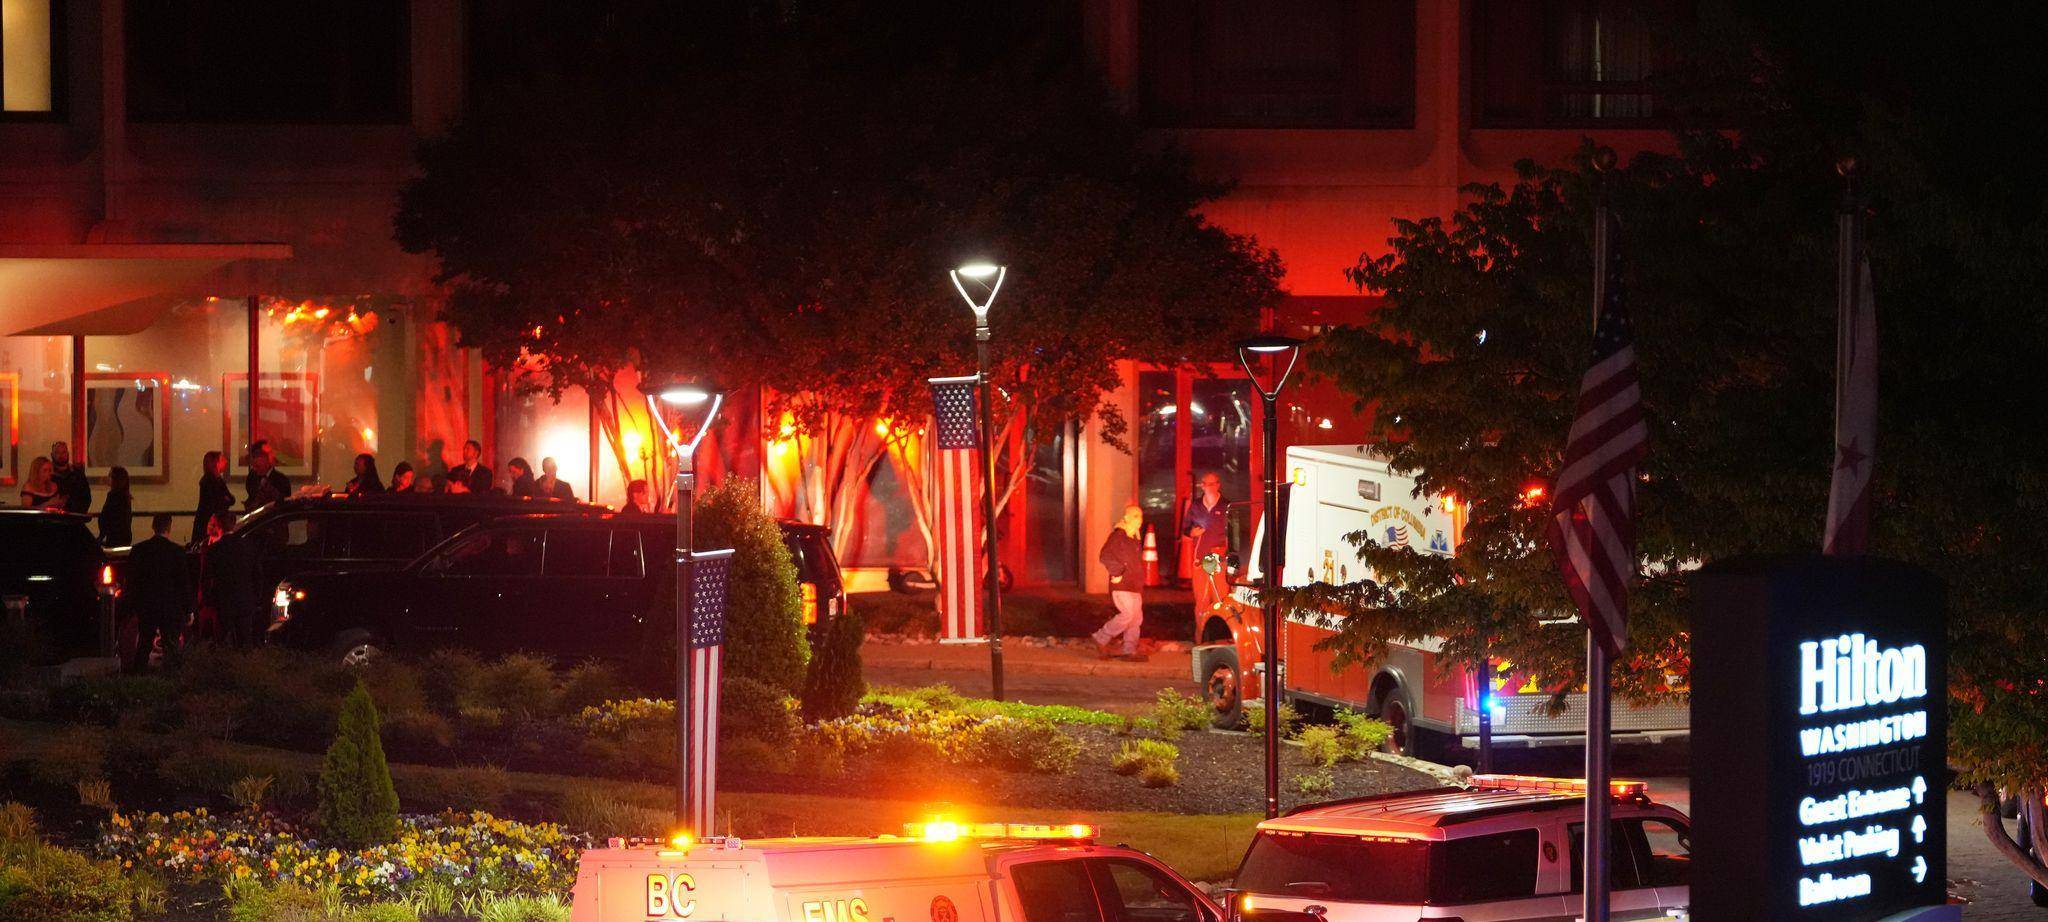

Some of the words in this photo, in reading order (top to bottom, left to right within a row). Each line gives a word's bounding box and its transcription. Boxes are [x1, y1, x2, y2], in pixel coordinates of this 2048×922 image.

[1800, 633, 1927, 715] Hilton
[1800, 711, 1927, 756] WASHINGTON
[1807, 761, 1836, 786] 1919
[1838, 746, 1920, 782] CONNECTICUT
[1800, 797, 1848, 825] Guest
[1847, 787, 1910, 818] Entrance
[1799, 833, 1844, 865] Valet
[1843, 825, 1900, 858] Parking
[646, 873, 696, 918] BC
[1799, 873, 1871, 906] Ballroom
